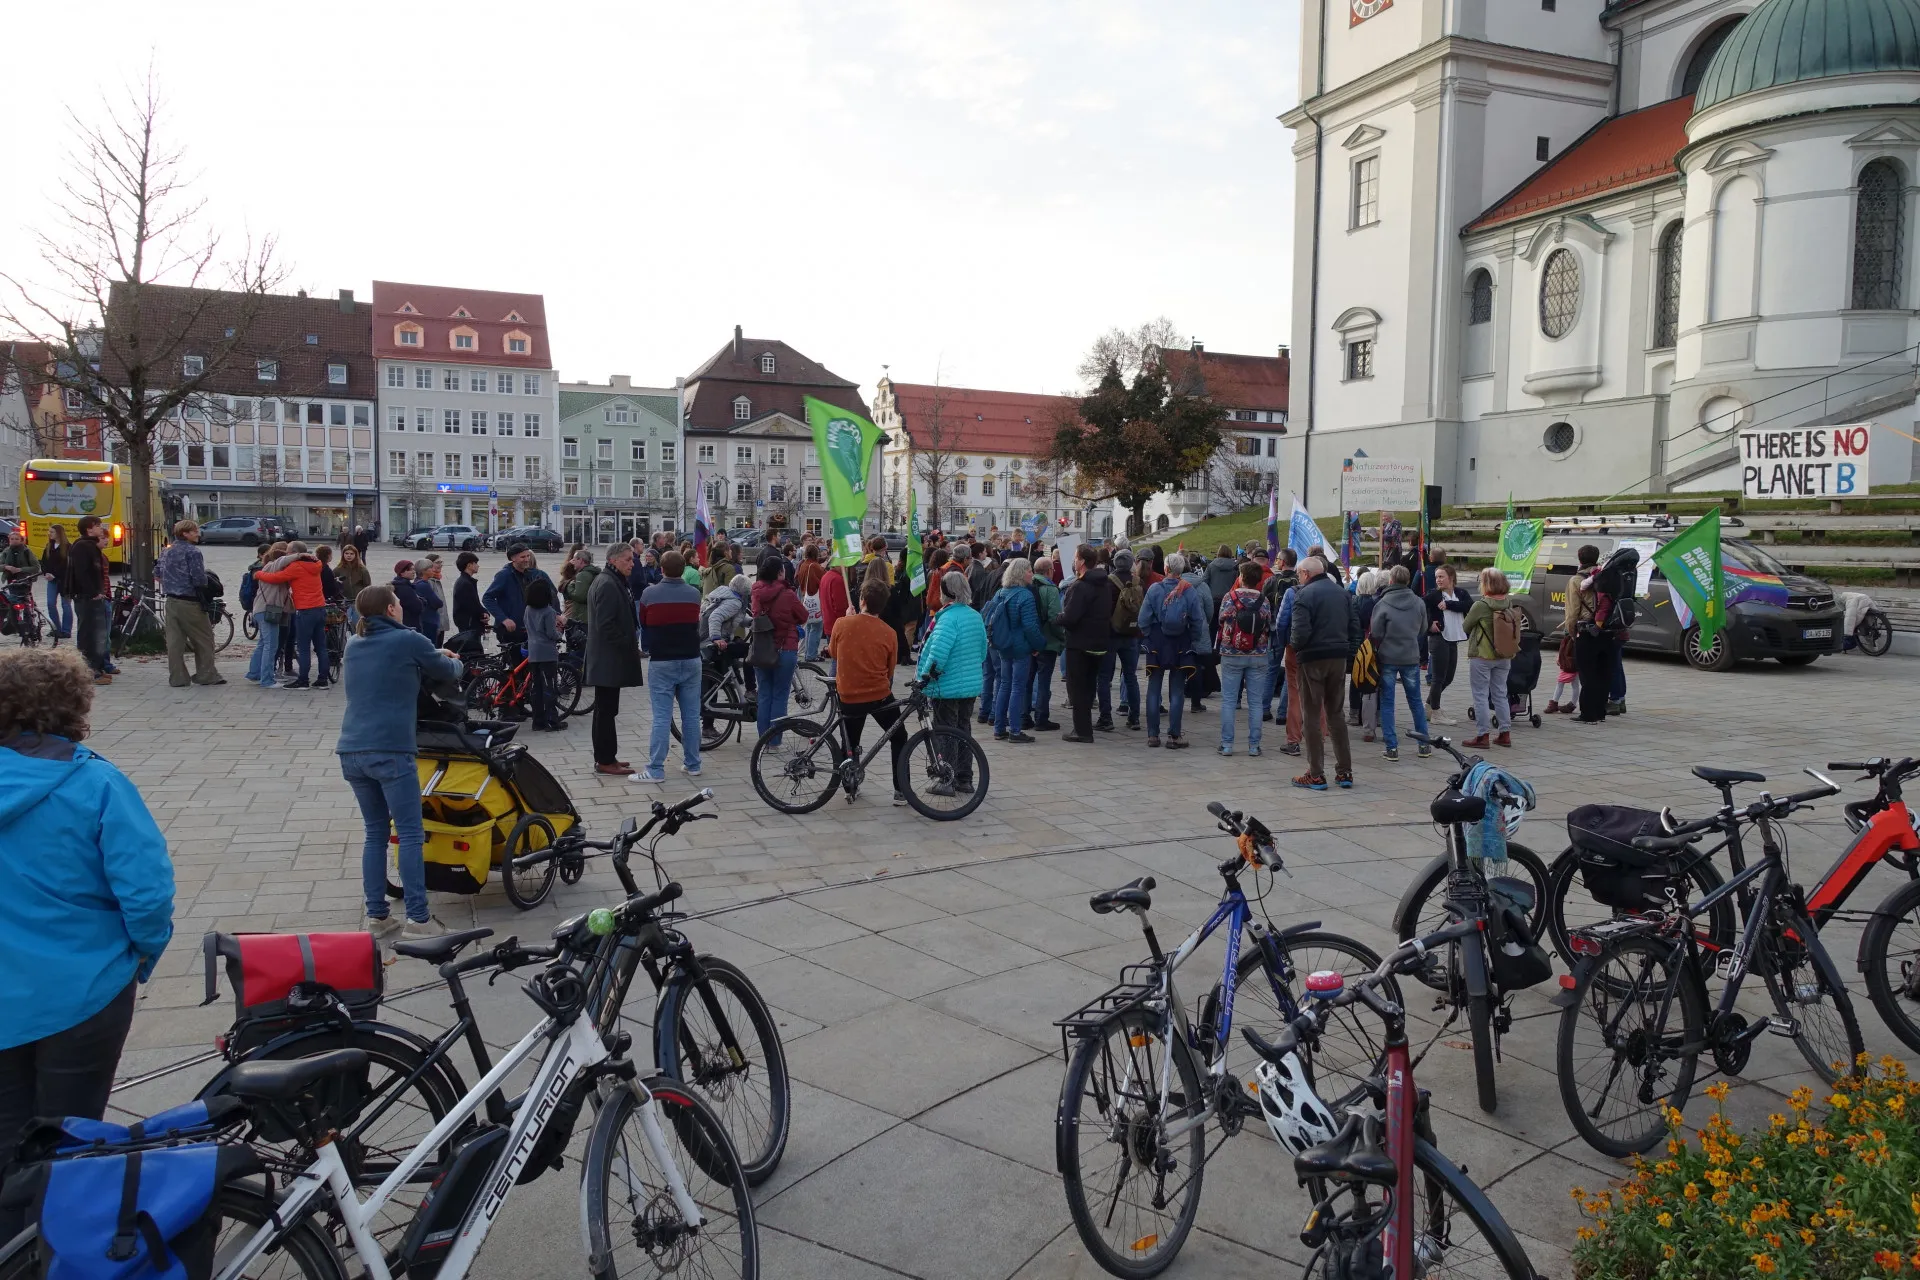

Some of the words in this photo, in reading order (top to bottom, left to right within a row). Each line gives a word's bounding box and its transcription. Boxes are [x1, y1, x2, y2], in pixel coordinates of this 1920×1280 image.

[1740, 432, 1802, 459] THERE
[1805, 430, 1826, 458] IS
[1834, 427, 1868, 456] NO
[1744, 463, 1832, 495] PLANET
[1837, 463, 1856, 493] B
[1680, 551, 1695, 568] DIE
[1224, 929, 1241, 1016] TREK
[485, 1055, 575, 1221] CENTURION
